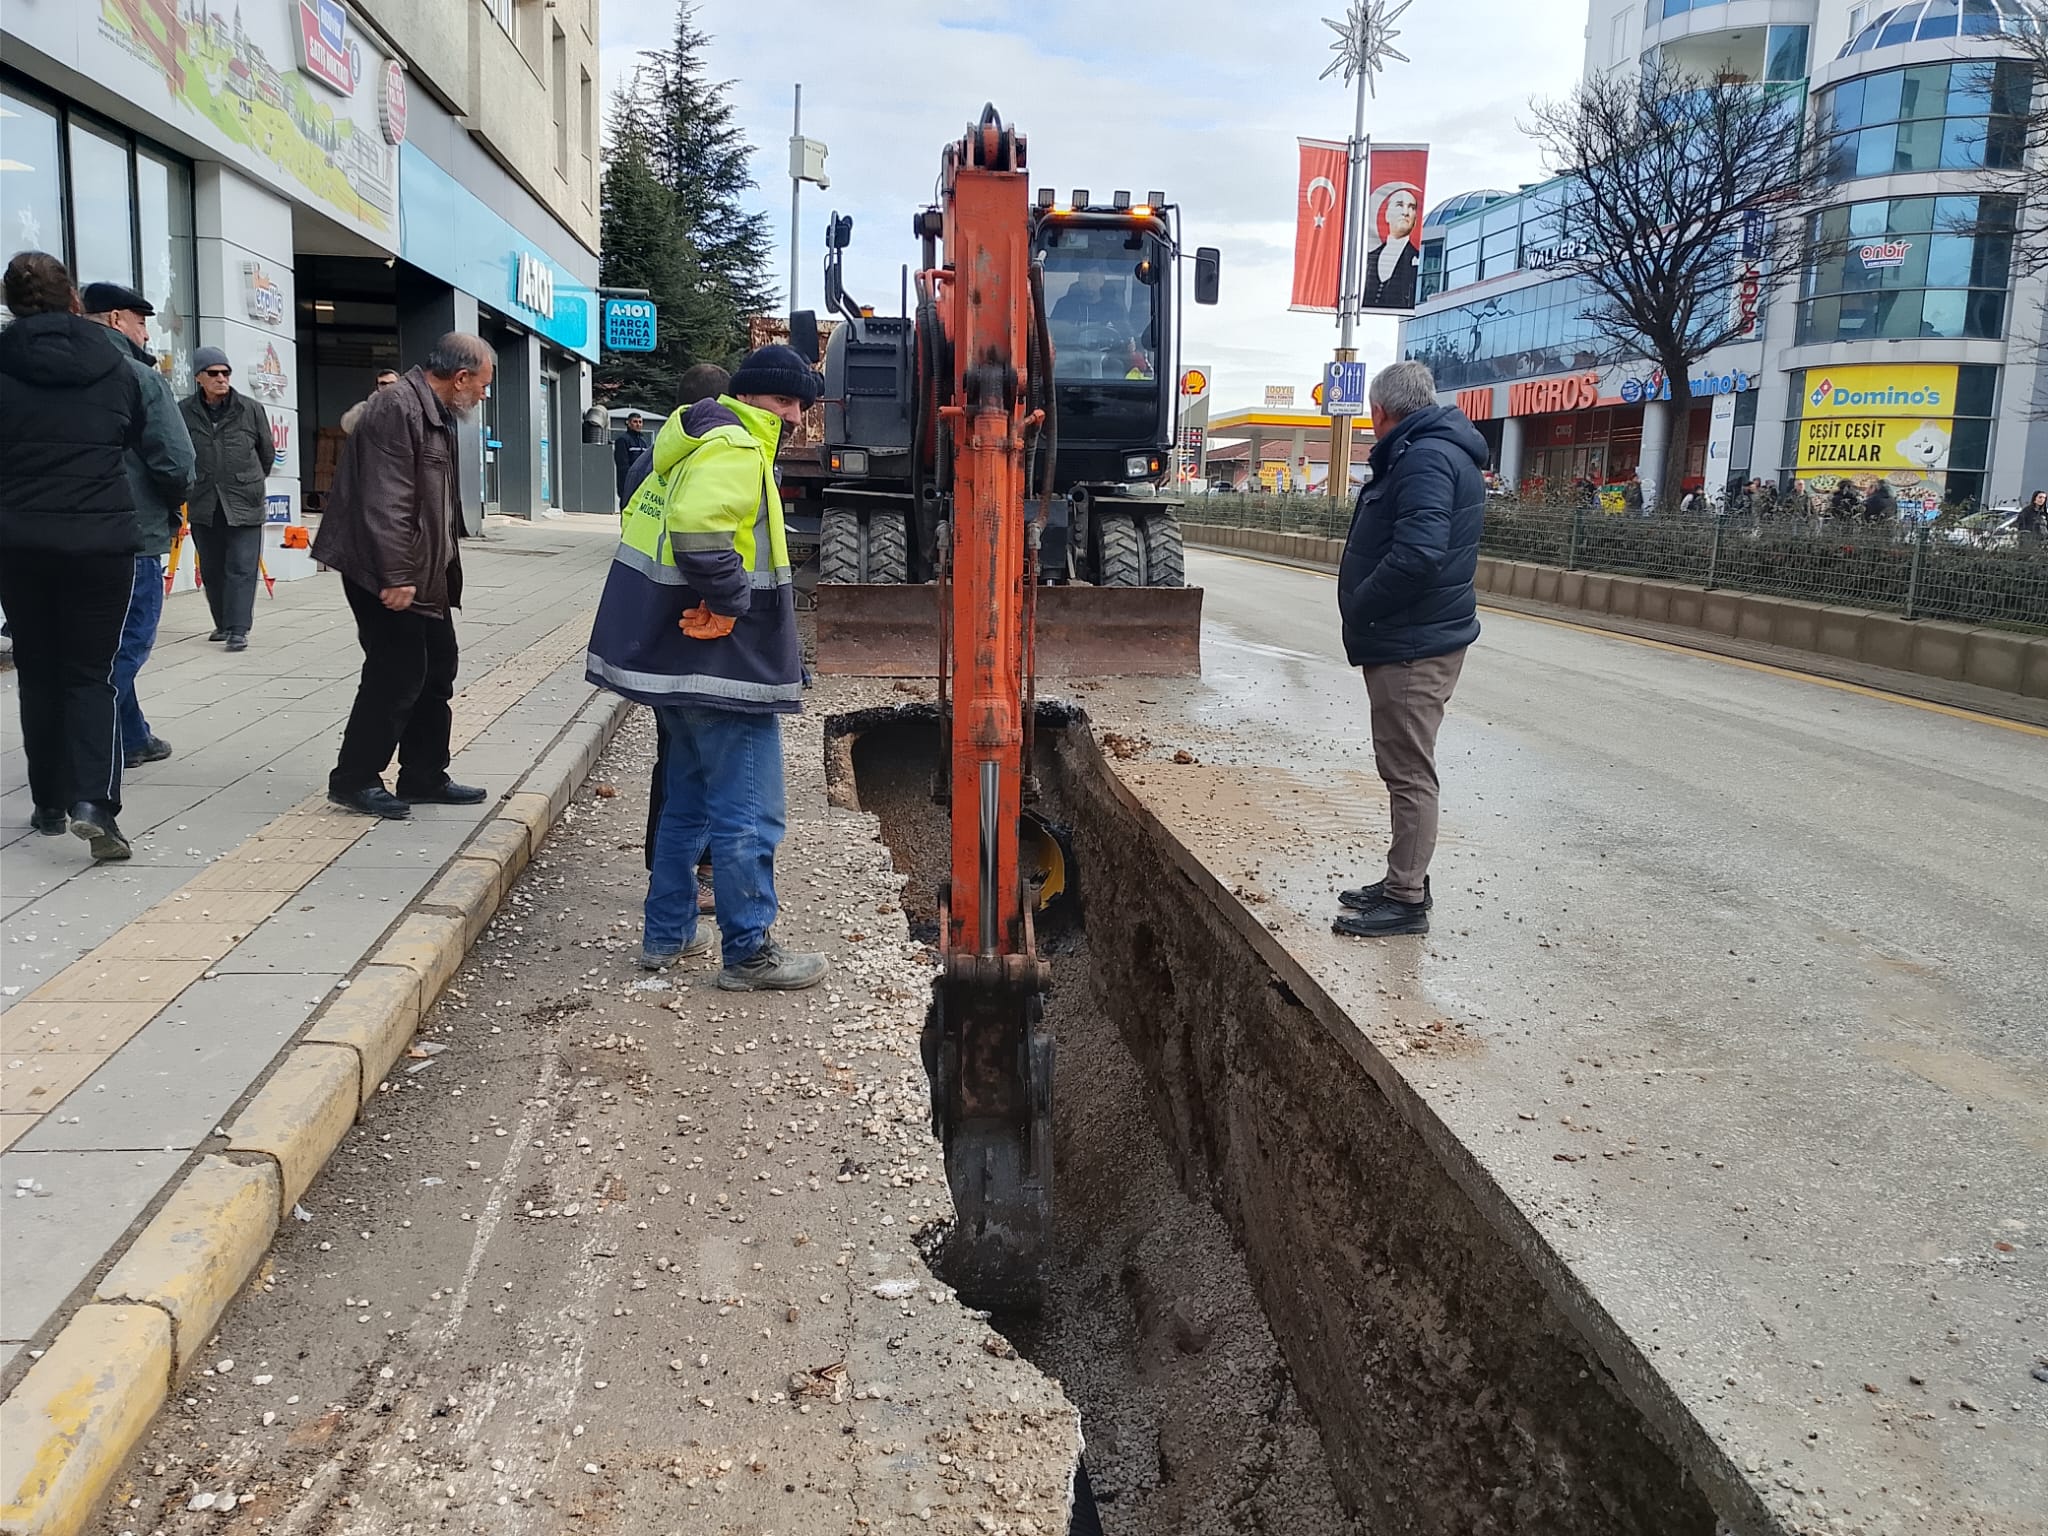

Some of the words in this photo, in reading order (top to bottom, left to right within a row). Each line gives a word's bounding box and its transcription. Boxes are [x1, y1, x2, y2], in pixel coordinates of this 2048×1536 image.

[1527, 238, 1587, 268] WALKER'S
[610, 318, 650, 329] HARCA
[610, 328, 650, 338] HARCA
[1663, 368, 1749, 400] Dmino's
[1833, 385, 1940, 406] Domino's
[1809, 421, 1841, 440] ÇEŞİT
[1845, 420, 1886, 440] ÇEŞİT
[1807, 441, 1881, 462] PİZZALAR
